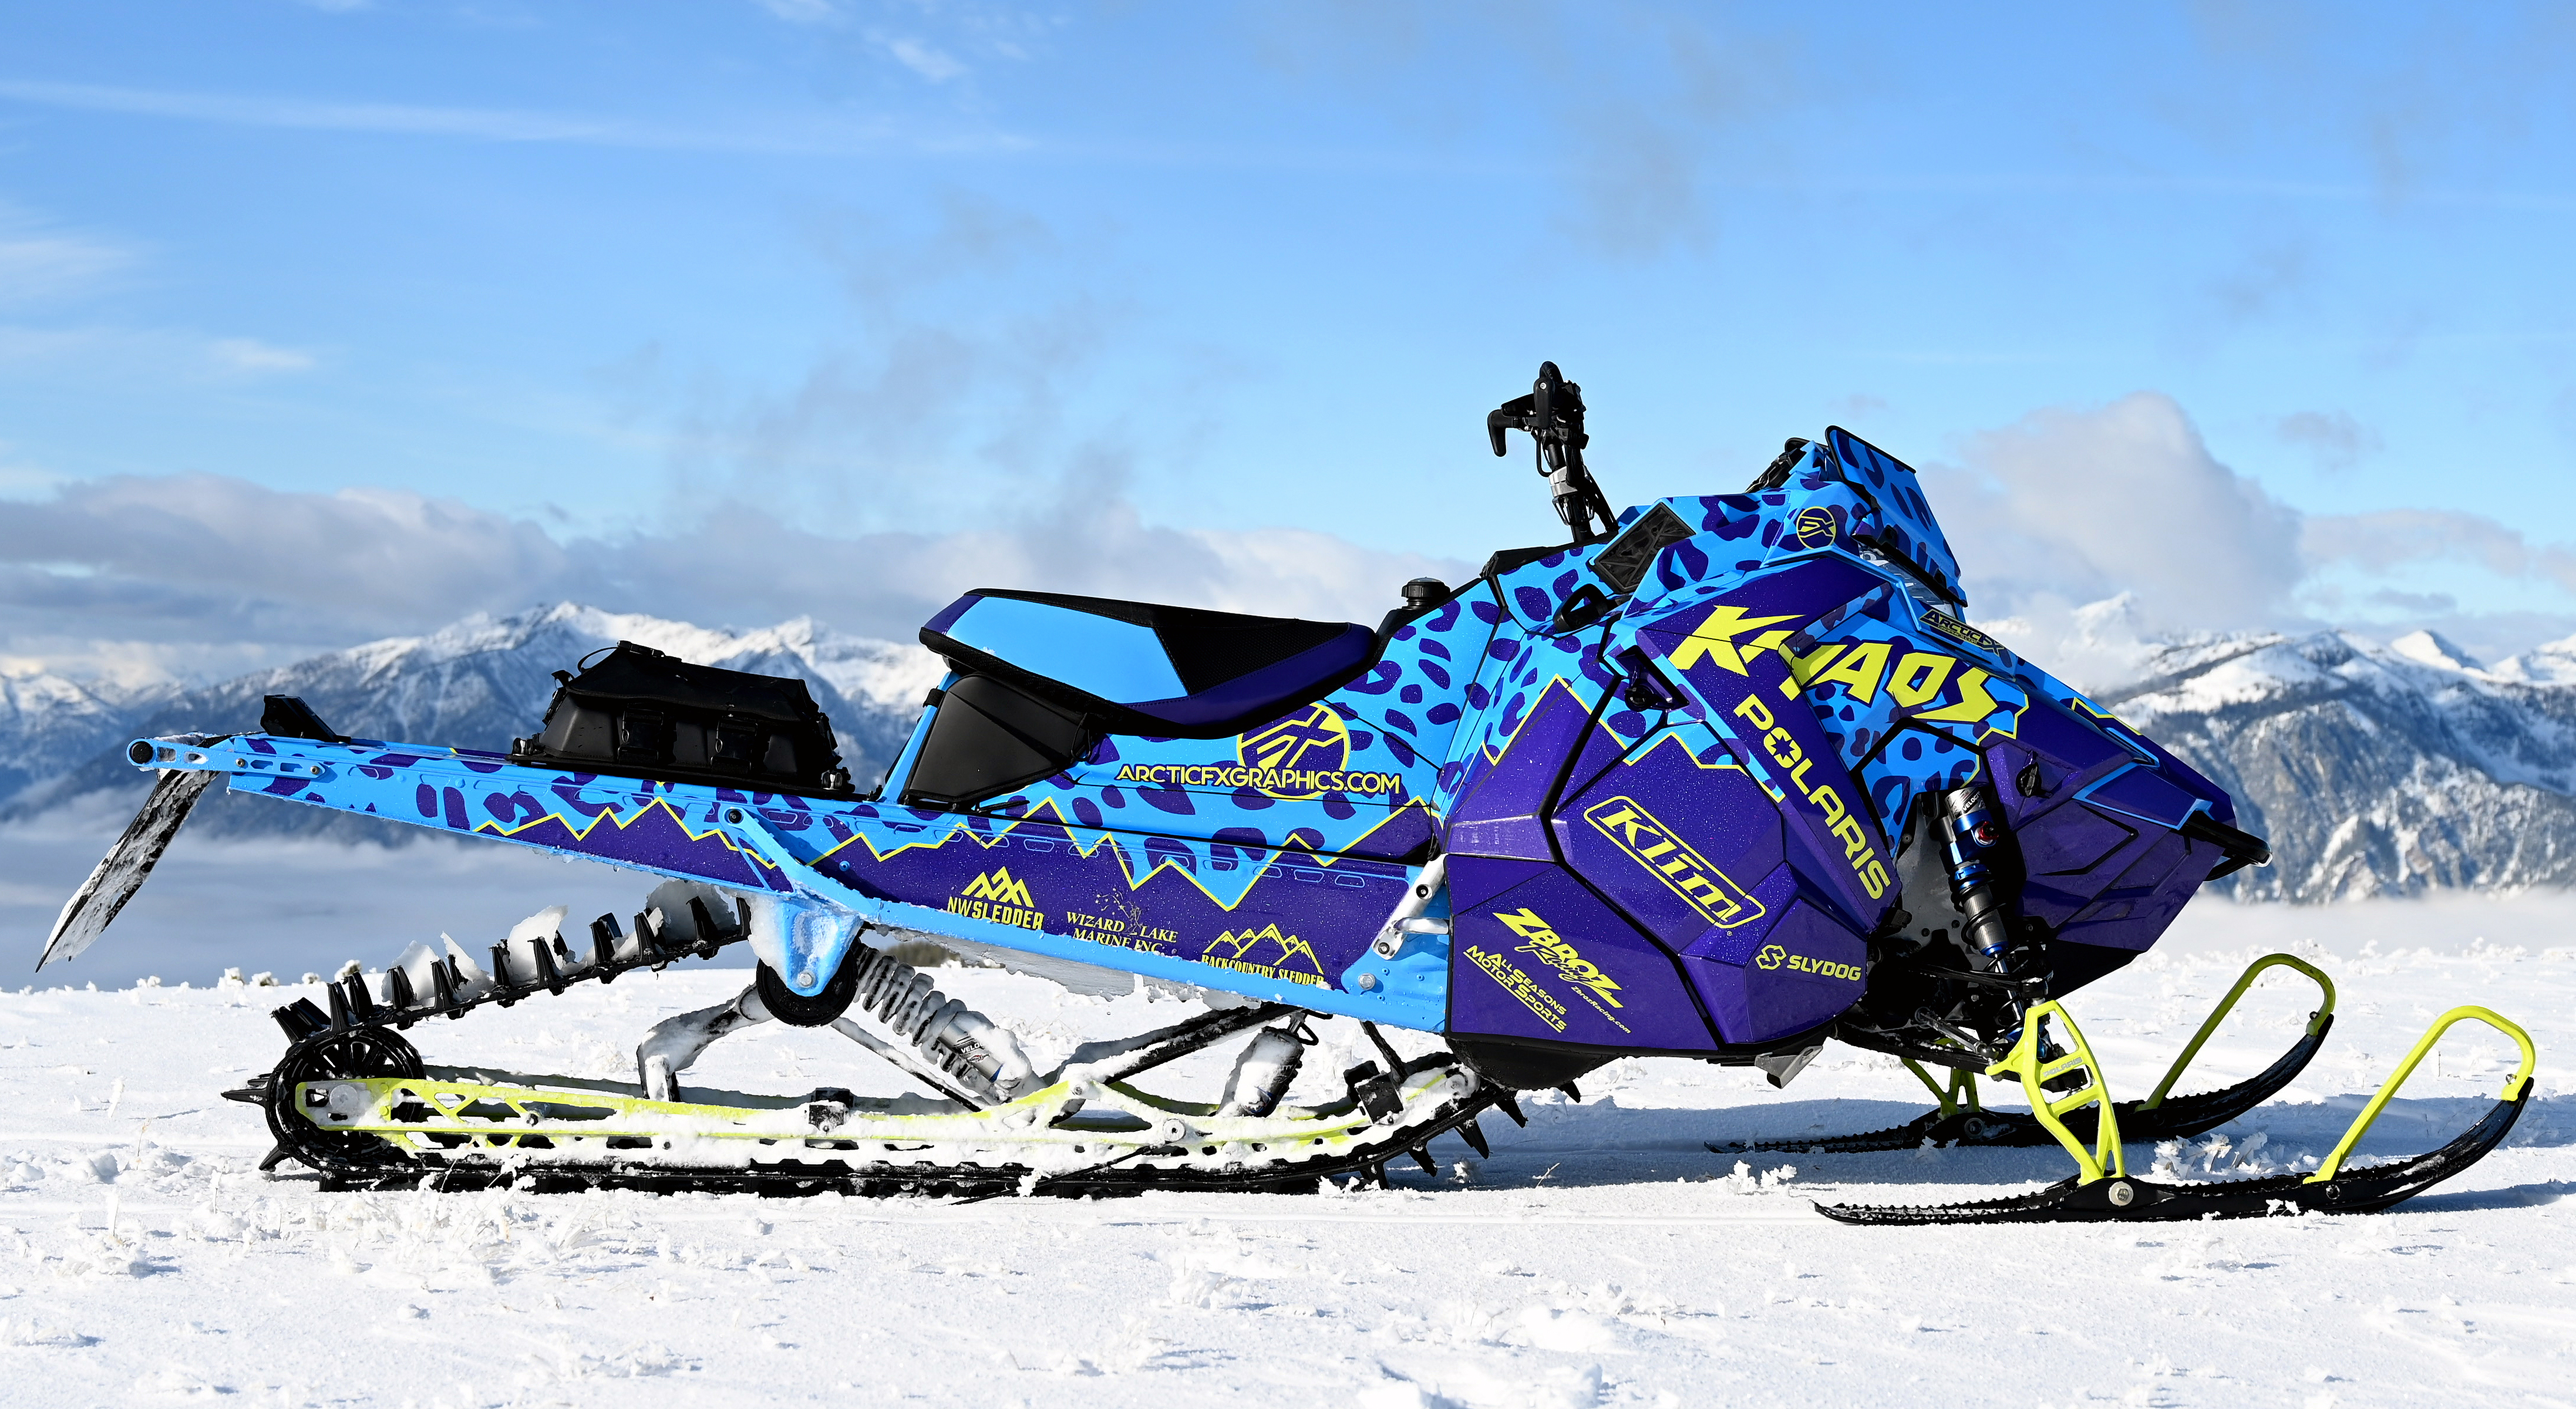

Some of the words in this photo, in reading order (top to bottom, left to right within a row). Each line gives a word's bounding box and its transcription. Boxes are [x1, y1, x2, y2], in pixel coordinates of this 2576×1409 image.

[1116, 765, 1402, 794] ARCTICFXGRAPHICS.COM
[1733, 693, 1890, 899] POLARIS
[1066, 911, 1125, 932] WIZARD
[1140, 925, 1178, 943] LAKE
[1073, 928, 1132, 948] MARINE
[1201, 955, 1276, 979] BACKCOUNTRY
[1492, 908, 1624, 1008] ZBROZ
[1514, 941, 1612, 996] Racing
[1787, 955, 1862, 981] SLYDOG
[1466, 945, 1515, 987] MOTOR
[1514, 984, 1567, 1031] SPORTS
[1571, 986, 1631, 1034] ZbrozRacing.com
[961, 1043, 984, 1053] VELO
[2043, 1057, 2083, 1078] POLARIS
